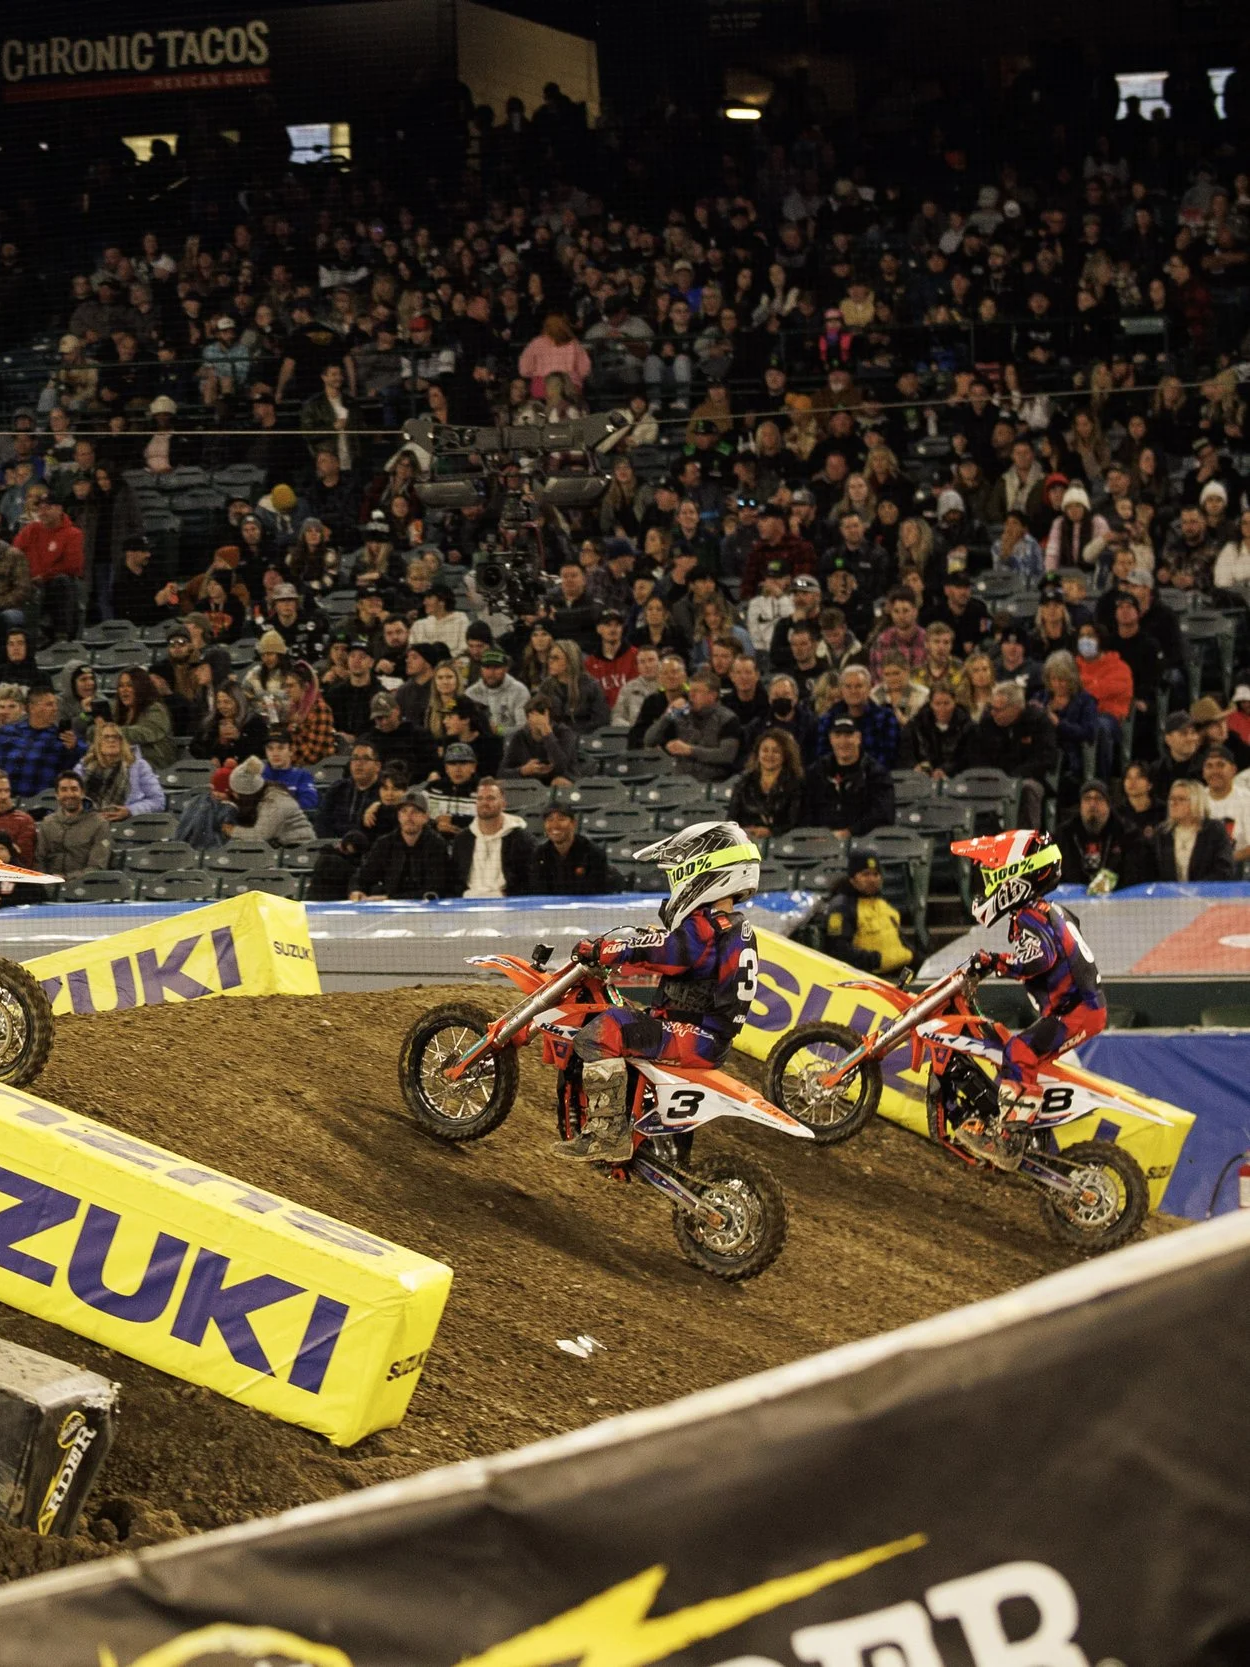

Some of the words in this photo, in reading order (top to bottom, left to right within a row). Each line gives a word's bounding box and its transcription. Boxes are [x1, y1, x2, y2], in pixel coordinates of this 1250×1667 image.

[2, 32, 154, 82] CHRONIC
[158, 20, 270, 67] TACOS
[671, 856, 712, 884] 100%
[991, 858, 1035, 883] 100%
[40, 925, 242, 1014] UKI
[736, 947, 758, 1002] 3
[540, 1022, 567, 1037] KTM
[666, 1090, 705, 1119] 3
[1041, 1087, 1076, 1113] 8
